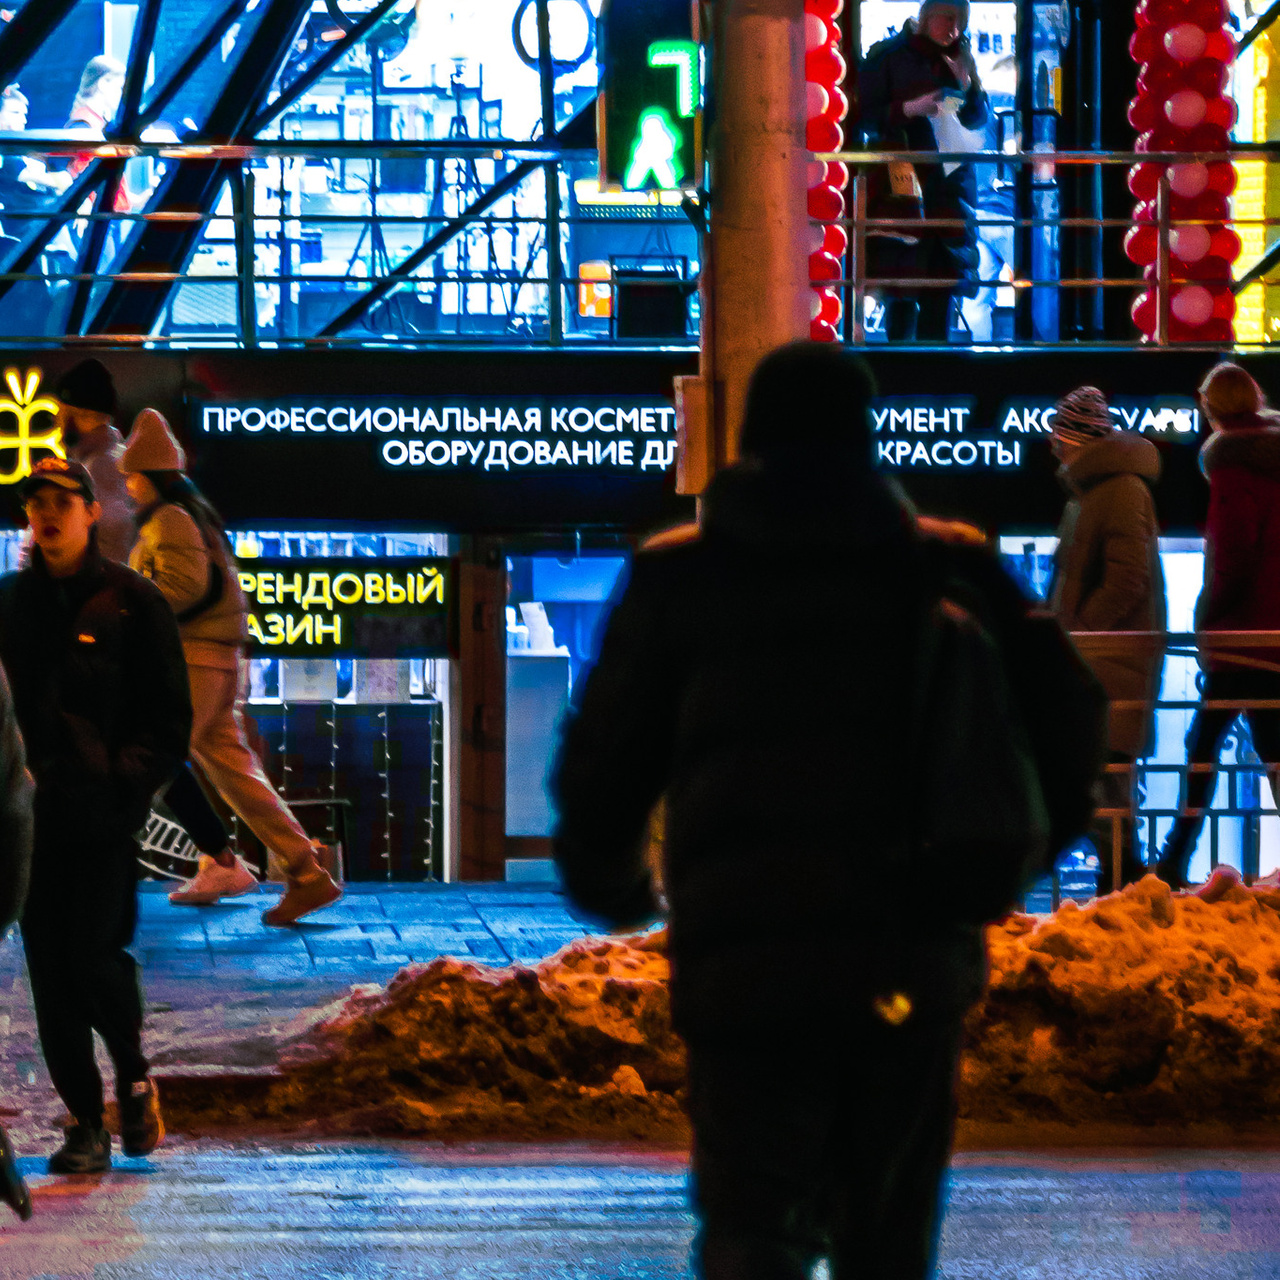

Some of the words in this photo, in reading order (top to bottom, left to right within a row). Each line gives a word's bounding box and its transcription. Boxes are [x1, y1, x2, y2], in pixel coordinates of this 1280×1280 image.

[203, 406, 542, 433] ПРОФЕССИОНАЛЬНАЯ
[551, 406, 677, 433] КОСМЕТ
[382, 439, 635, 471] ОБОРУДОВАНИЕ
[877, 440, 1021, 466] КРАСОТЫ
